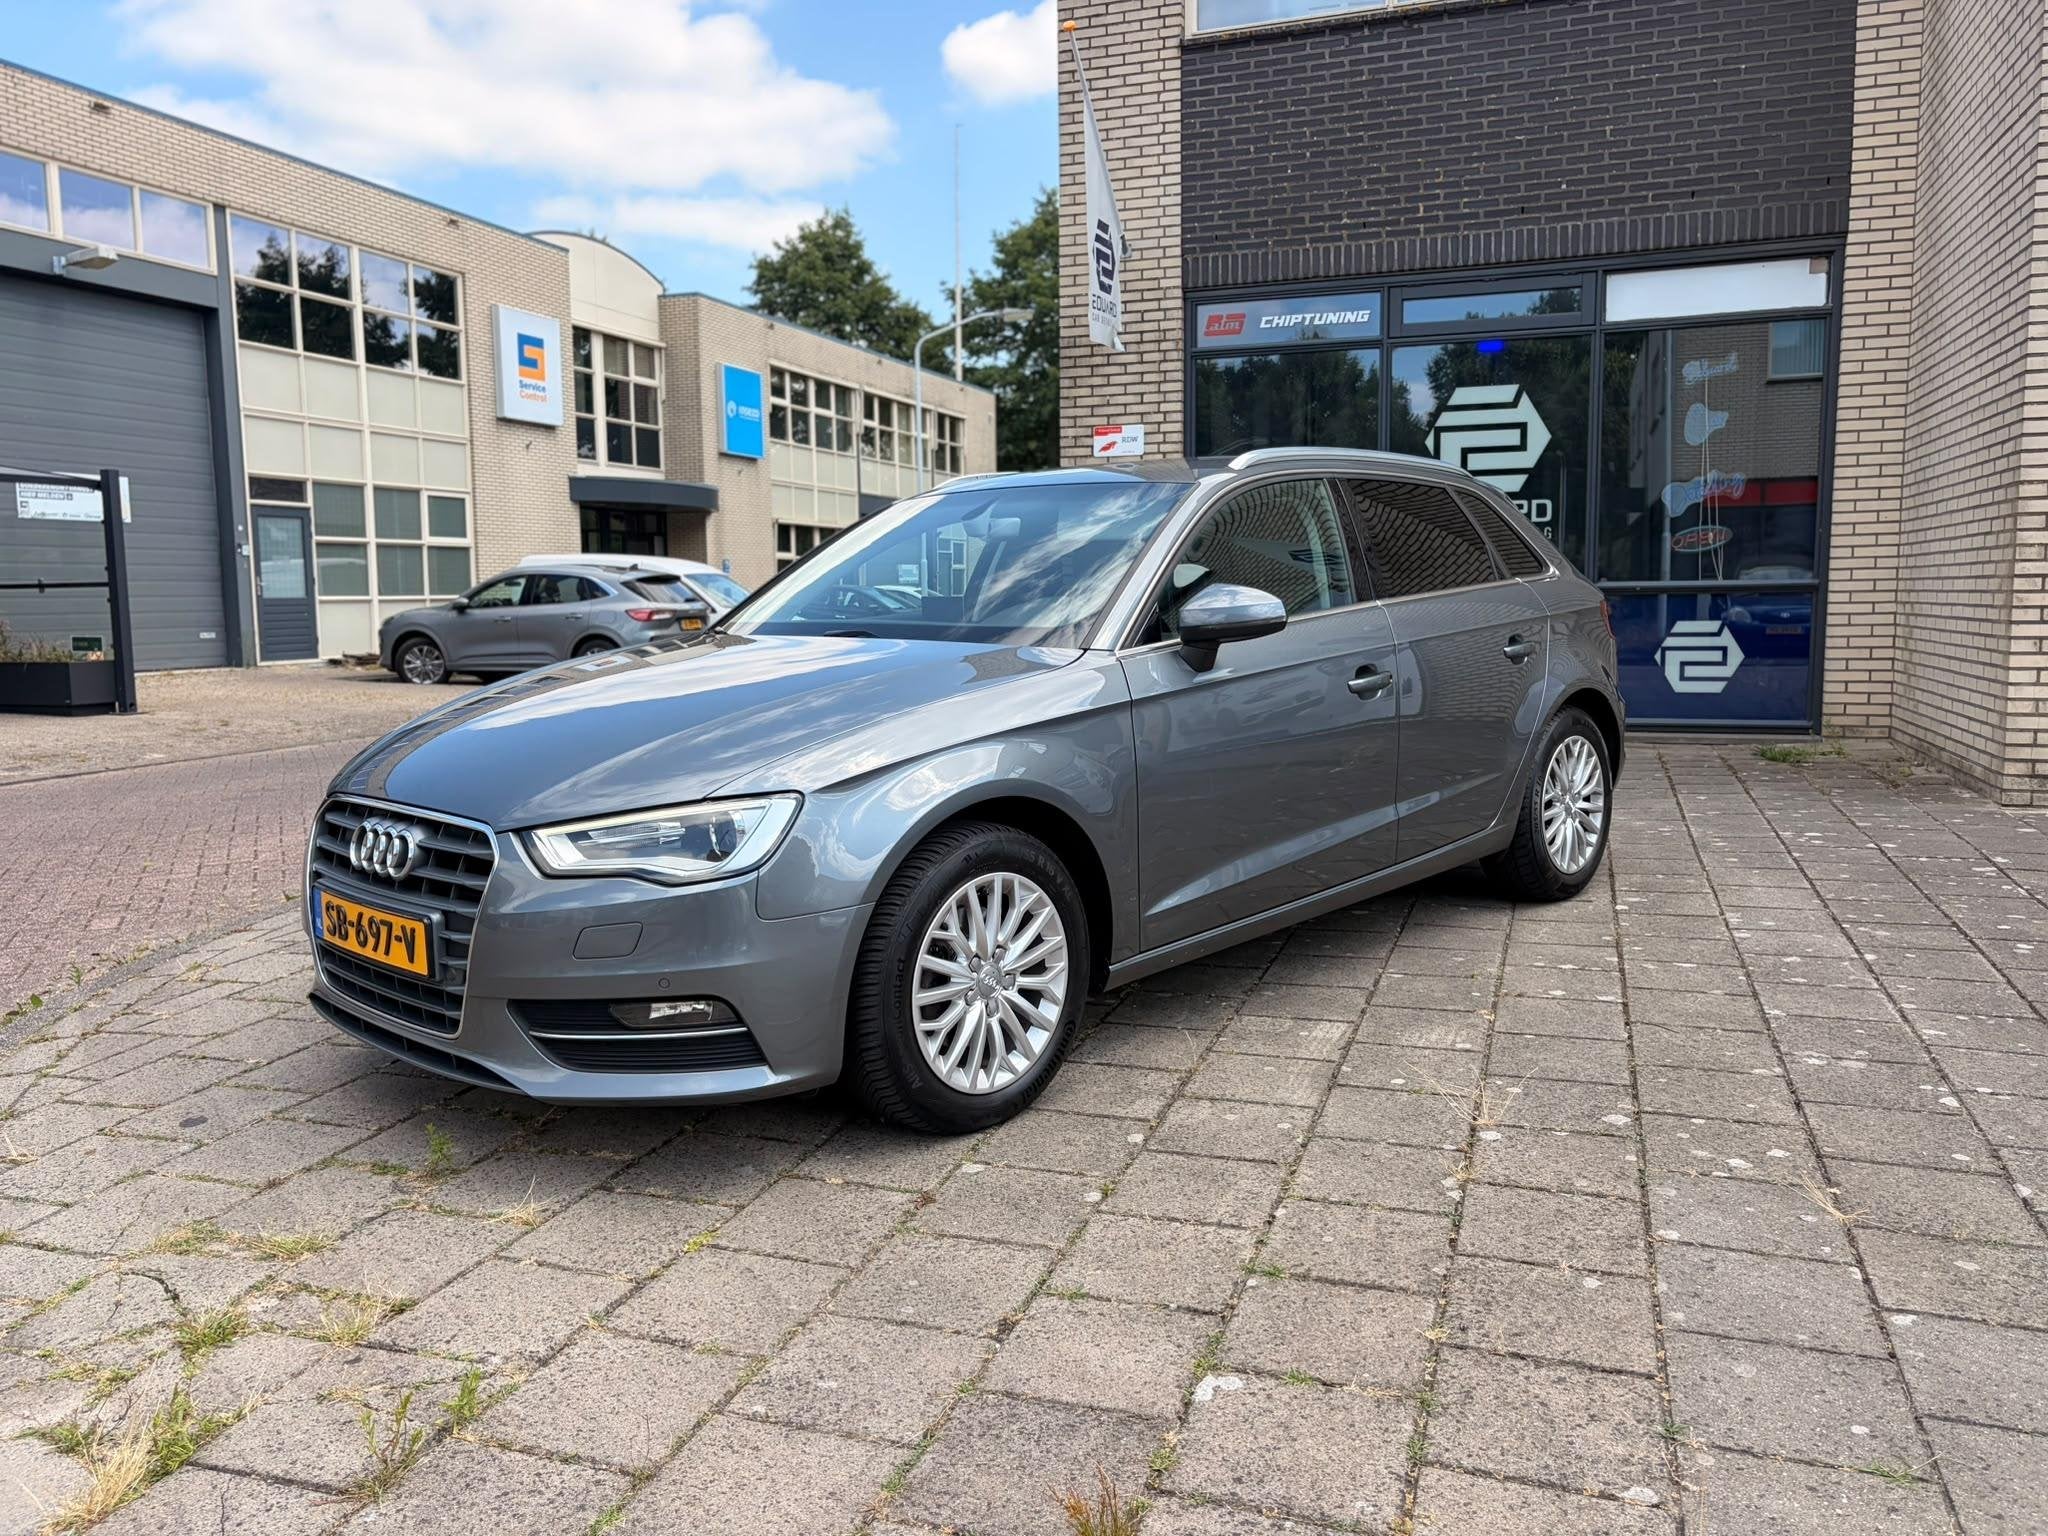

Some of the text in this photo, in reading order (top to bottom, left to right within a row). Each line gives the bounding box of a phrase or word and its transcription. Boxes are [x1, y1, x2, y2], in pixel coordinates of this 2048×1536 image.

[1259, 309, 1371, 329] CHIPTUNING
[519, 379, 547, 394] Service
[1121, 436, 1139, 444] RDW
[325, 901, 415, 963] SB-697-V
